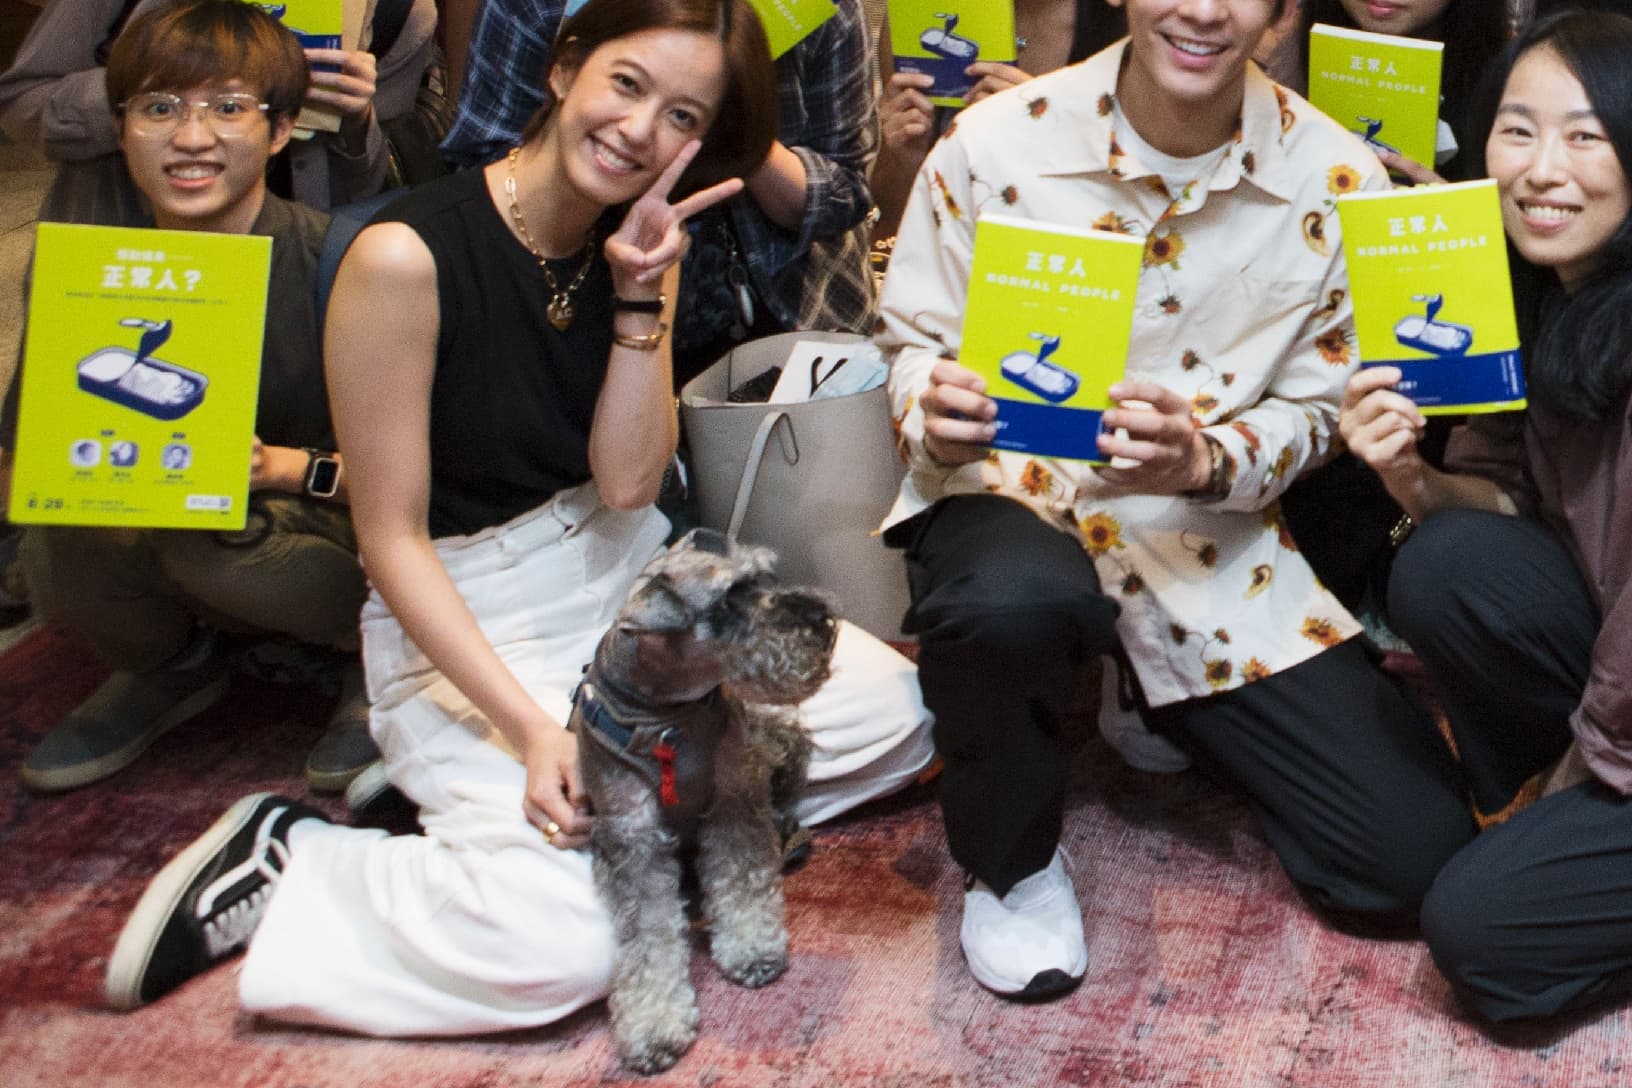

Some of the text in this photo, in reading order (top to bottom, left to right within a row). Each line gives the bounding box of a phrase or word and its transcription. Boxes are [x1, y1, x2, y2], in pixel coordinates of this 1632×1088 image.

[1351, 55, 1397, 76] 正常人
[1321, 71, 1426, 94] NORMAL PEOPLE
[1388, 213, 1448, 237] 正常人
[1357, 235, 1488, 257] NORMAL PEOPLE
[1024, 250, 1087, 279] 正常人
[985, 271, 1122, 301] NORMAL PEOPLE
